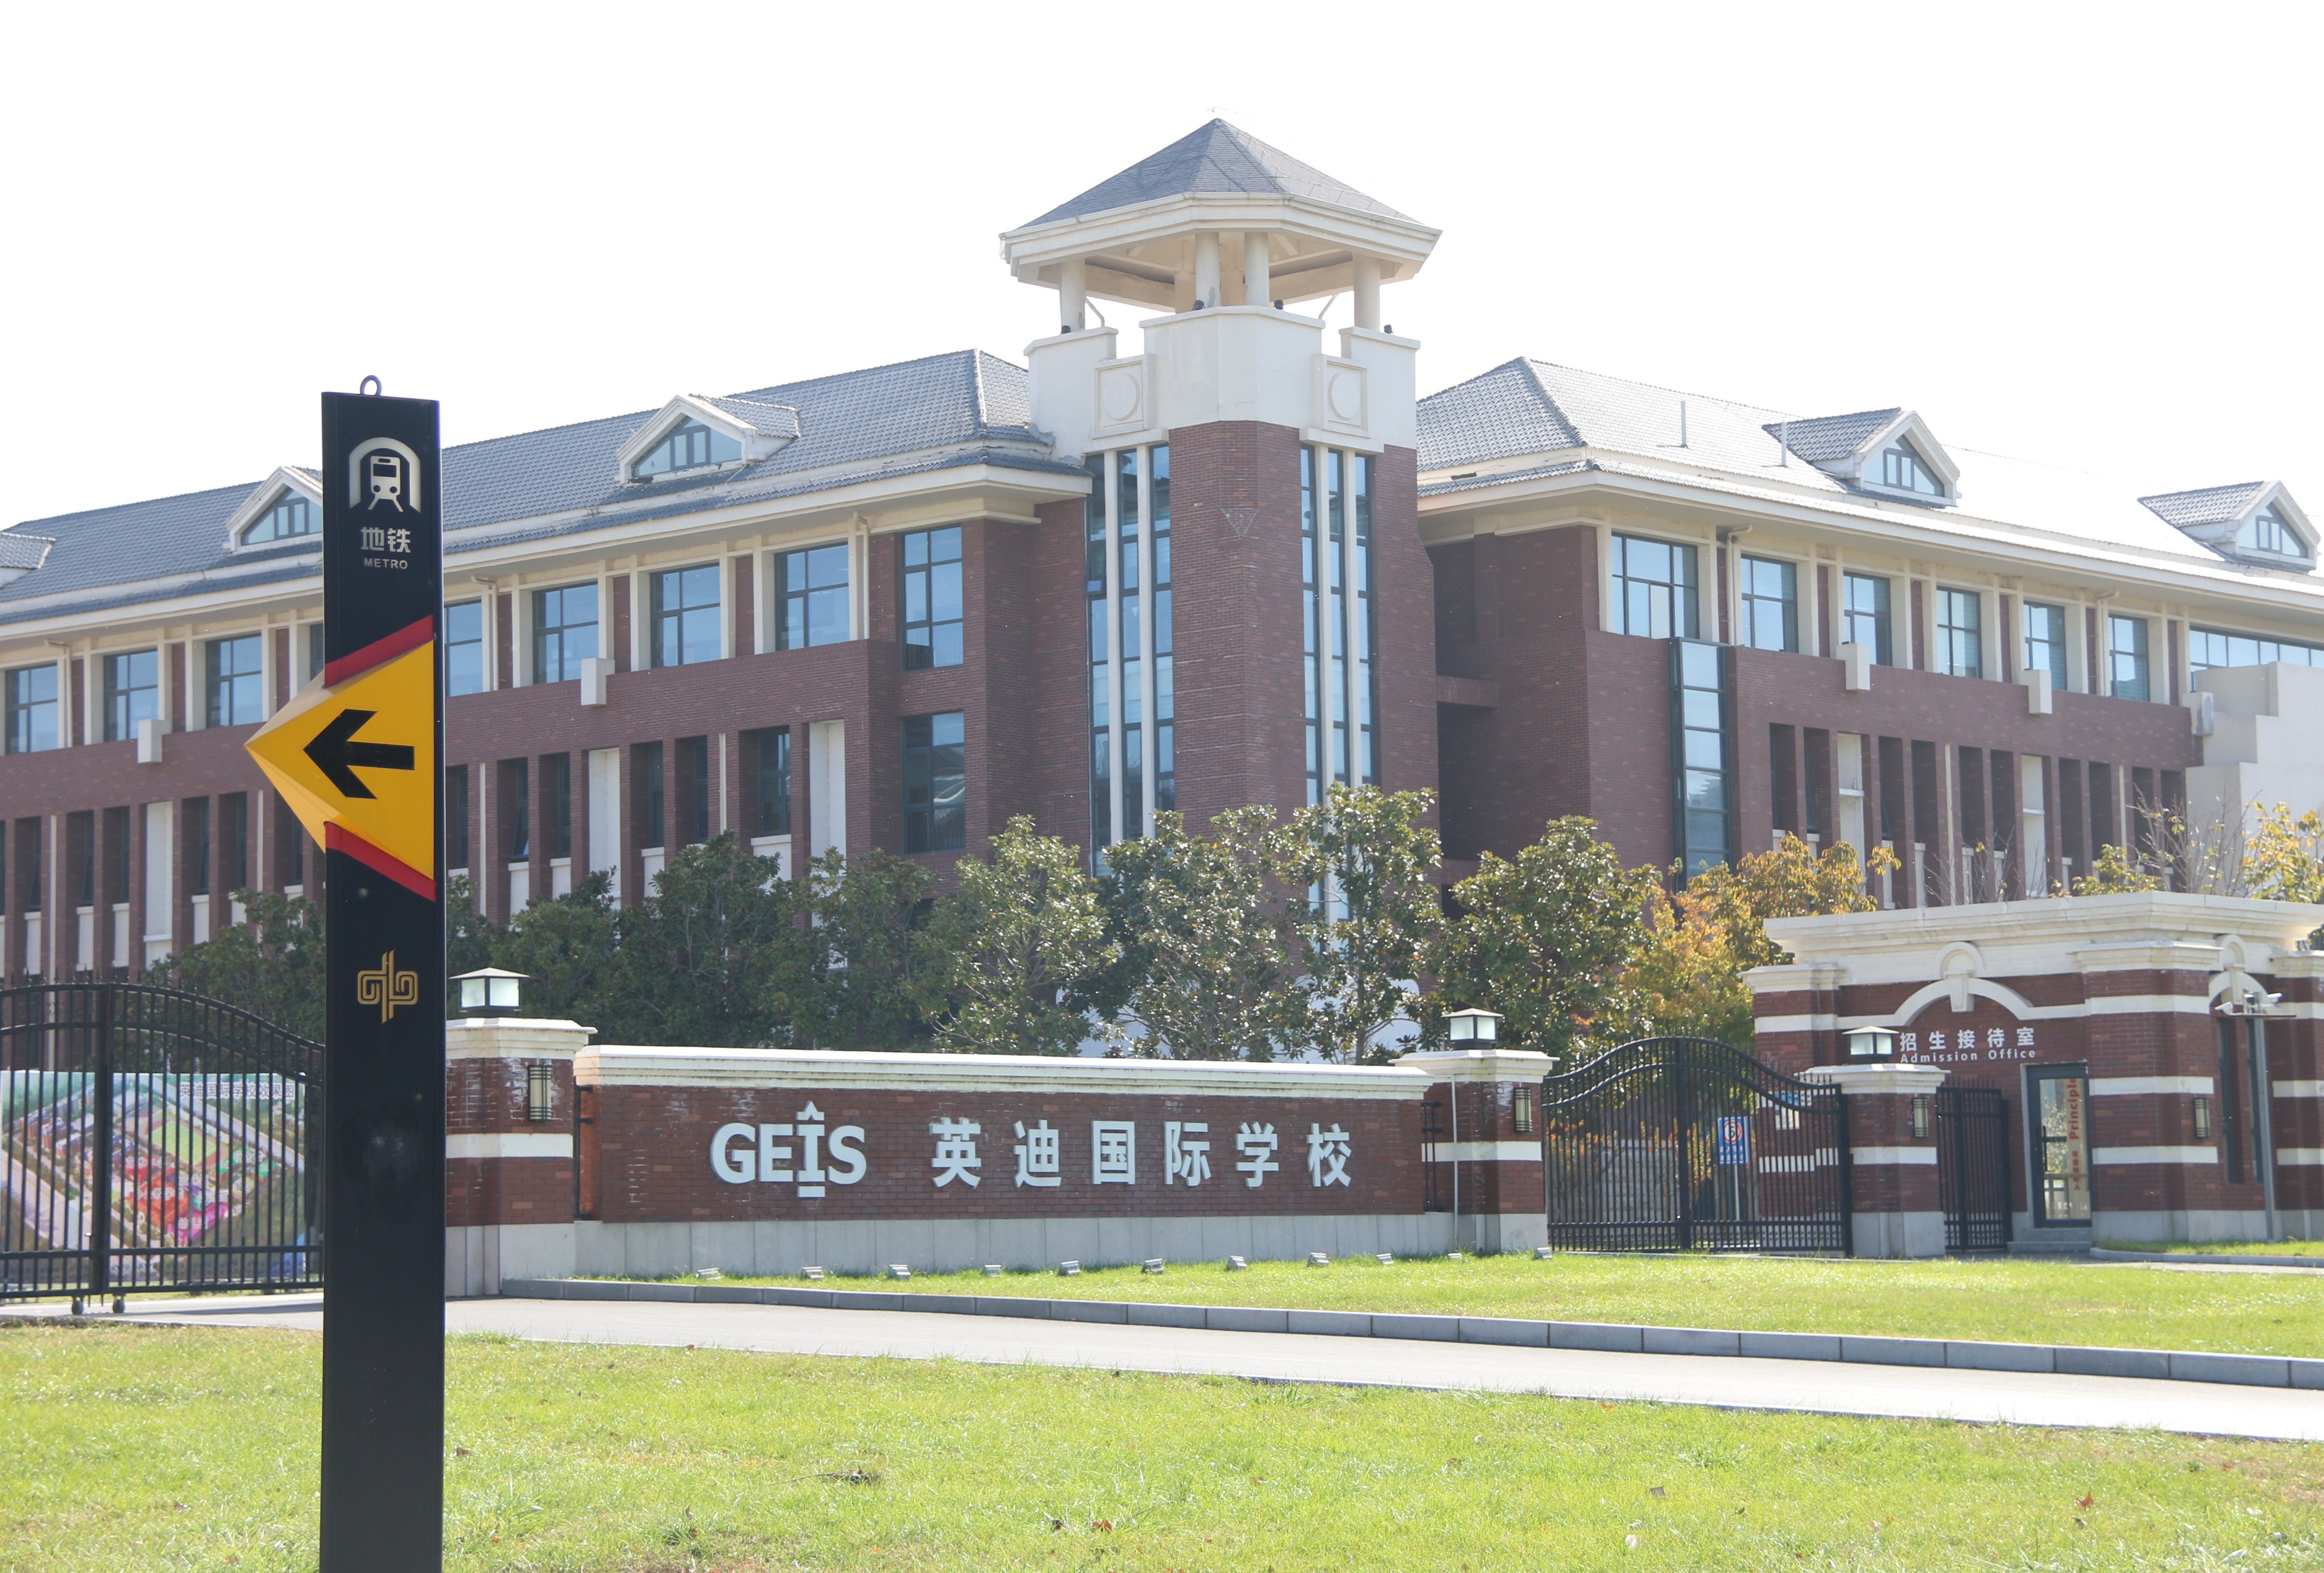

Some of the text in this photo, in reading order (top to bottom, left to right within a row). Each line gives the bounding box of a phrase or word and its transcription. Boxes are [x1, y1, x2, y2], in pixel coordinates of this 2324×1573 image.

[361, 527, 411, 552] 地铁
[364, 558, 408, 569] METRO
[1900, 1027, 2035, 1052] 招生接待室
[1900, 1049, 2035, 1063] Admission Office
[710, 1101, 1352, 1198] GEIS 英迪国际学校
